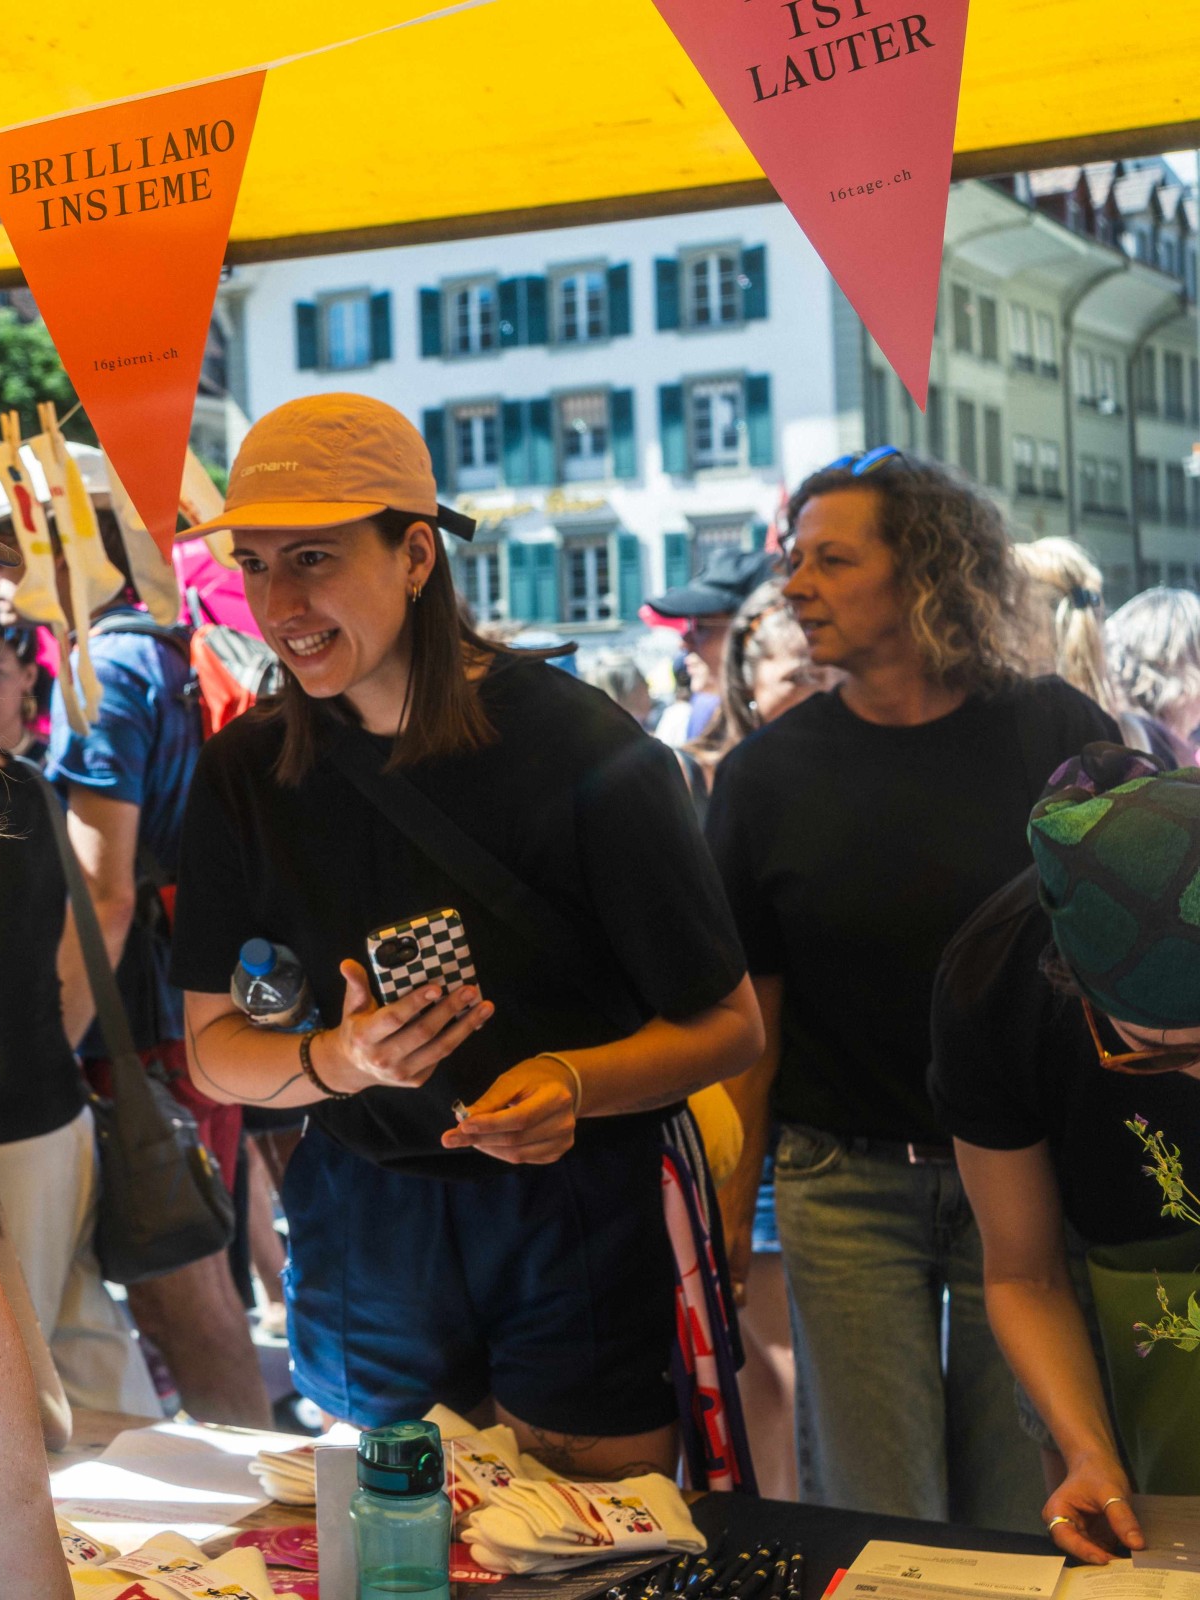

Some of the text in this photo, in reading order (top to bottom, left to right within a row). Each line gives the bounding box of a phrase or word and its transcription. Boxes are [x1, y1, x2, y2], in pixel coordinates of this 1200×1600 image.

[745, 14, 936, 104] LAUTER
[8, 119, 235, 195] BRILLIAMO
[829, 169, 912, 202] 16tage.ch
[37, 168, 212, 232] INSIEME
[93, 347, 179, 372] 16giorni.ch
